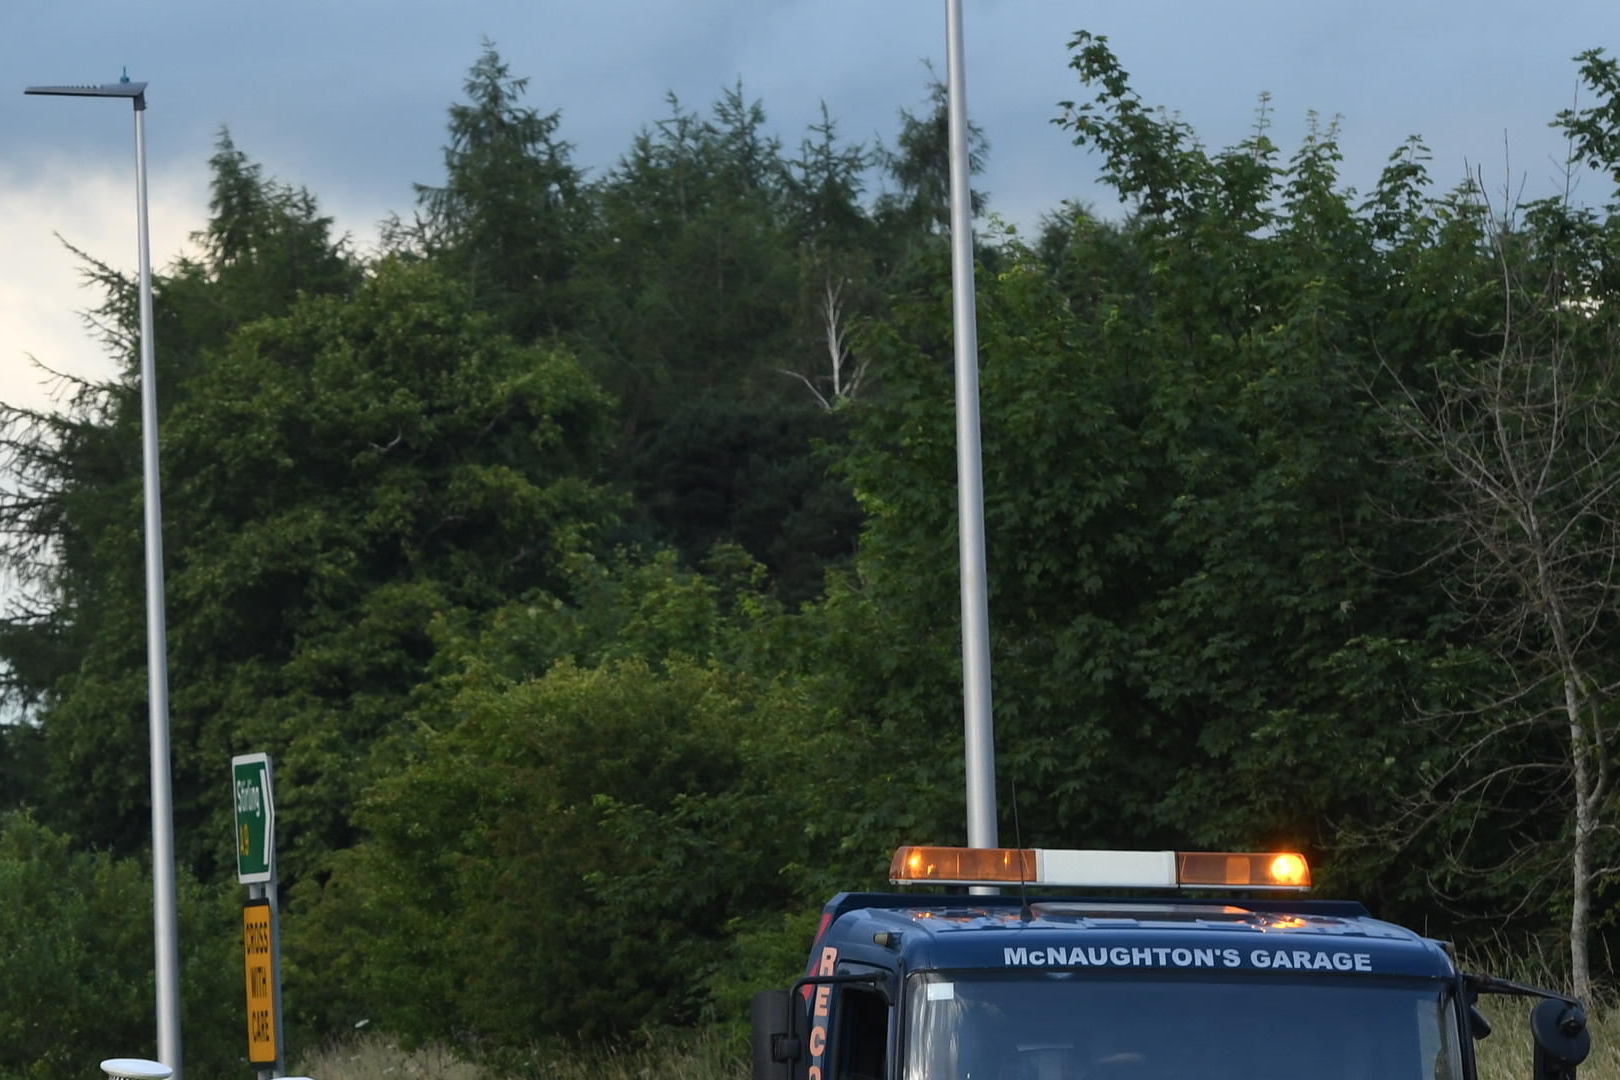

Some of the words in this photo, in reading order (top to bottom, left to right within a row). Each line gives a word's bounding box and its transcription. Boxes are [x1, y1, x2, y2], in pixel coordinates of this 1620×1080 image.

[236, 778, 261, 818] Stirling
[245, 920, 269, 955] CROSS
[1003, 946, 1242, 968] McNAUGHTON'S
[1249, 948, 1373, 972] GARAGE
[249, 965, 268, 999] WITH
[251, 1010, 270, 1043] CARE
